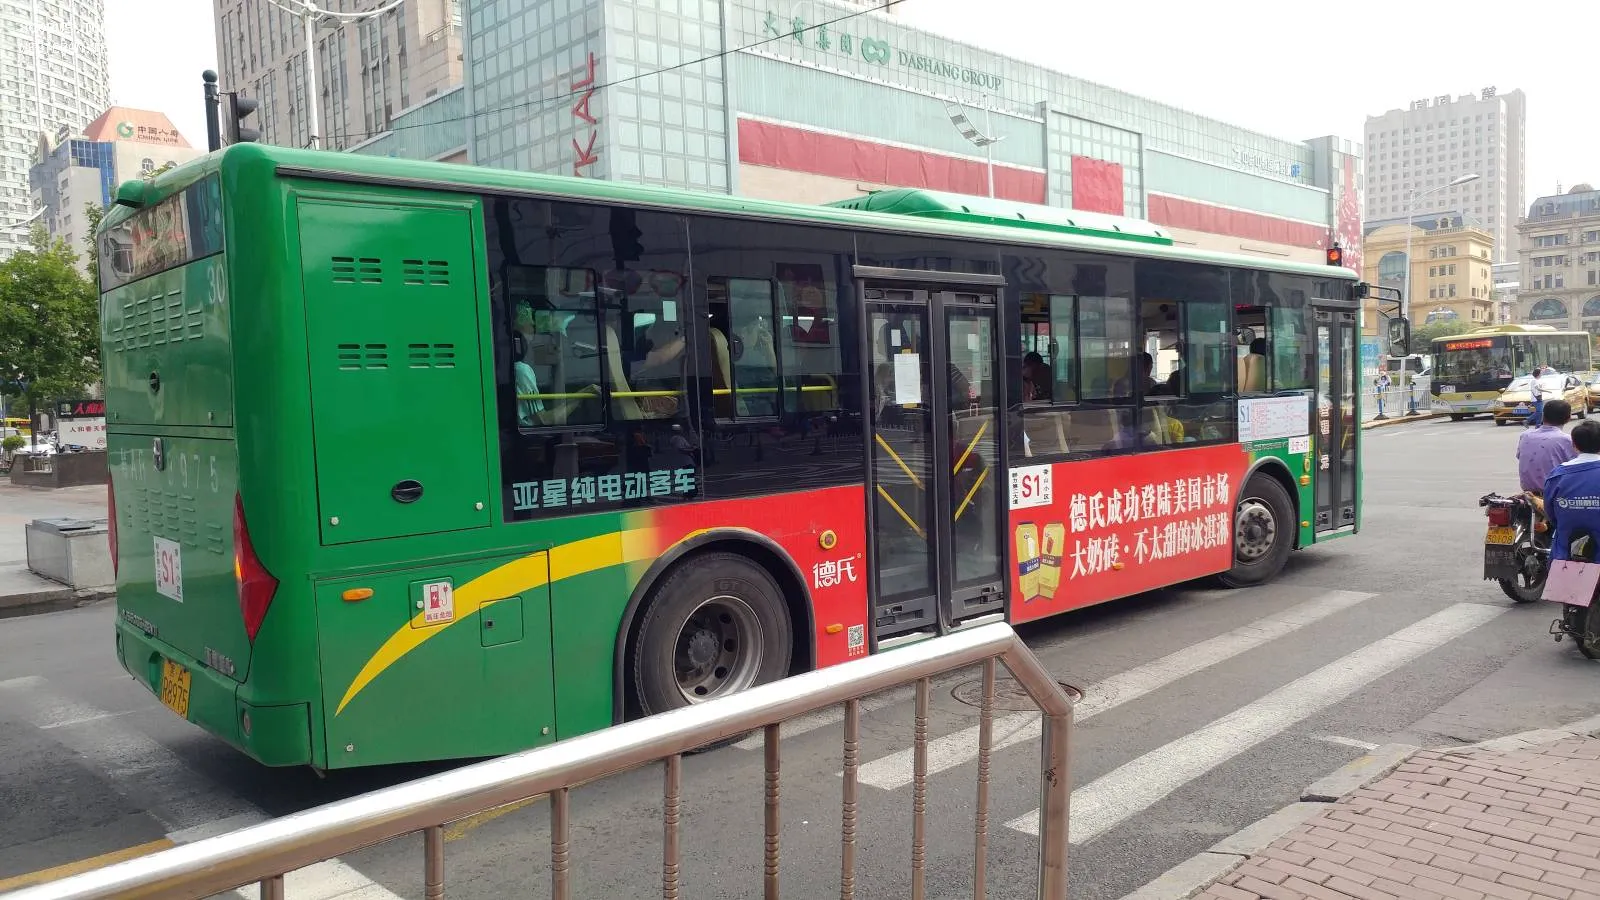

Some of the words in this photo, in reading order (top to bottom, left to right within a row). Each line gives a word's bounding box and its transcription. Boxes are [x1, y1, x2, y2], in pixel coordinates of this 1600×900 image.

[763, 9, 852, 56] 大商集团
[899, 50, 960, 81] DASHANG
[961, 67, 1001, 91] GROUP
[571, 51, 598, 177] KAL
[512, 467, 696, 511] 亚星纯电动客车
[1021, 474, 1041, 498] S1
[1069, 472, 1229, 533] 德氏成功登陆美国市场
[162, 550, 174, 585] S1
[812, 556, 857, 589] 德氏
